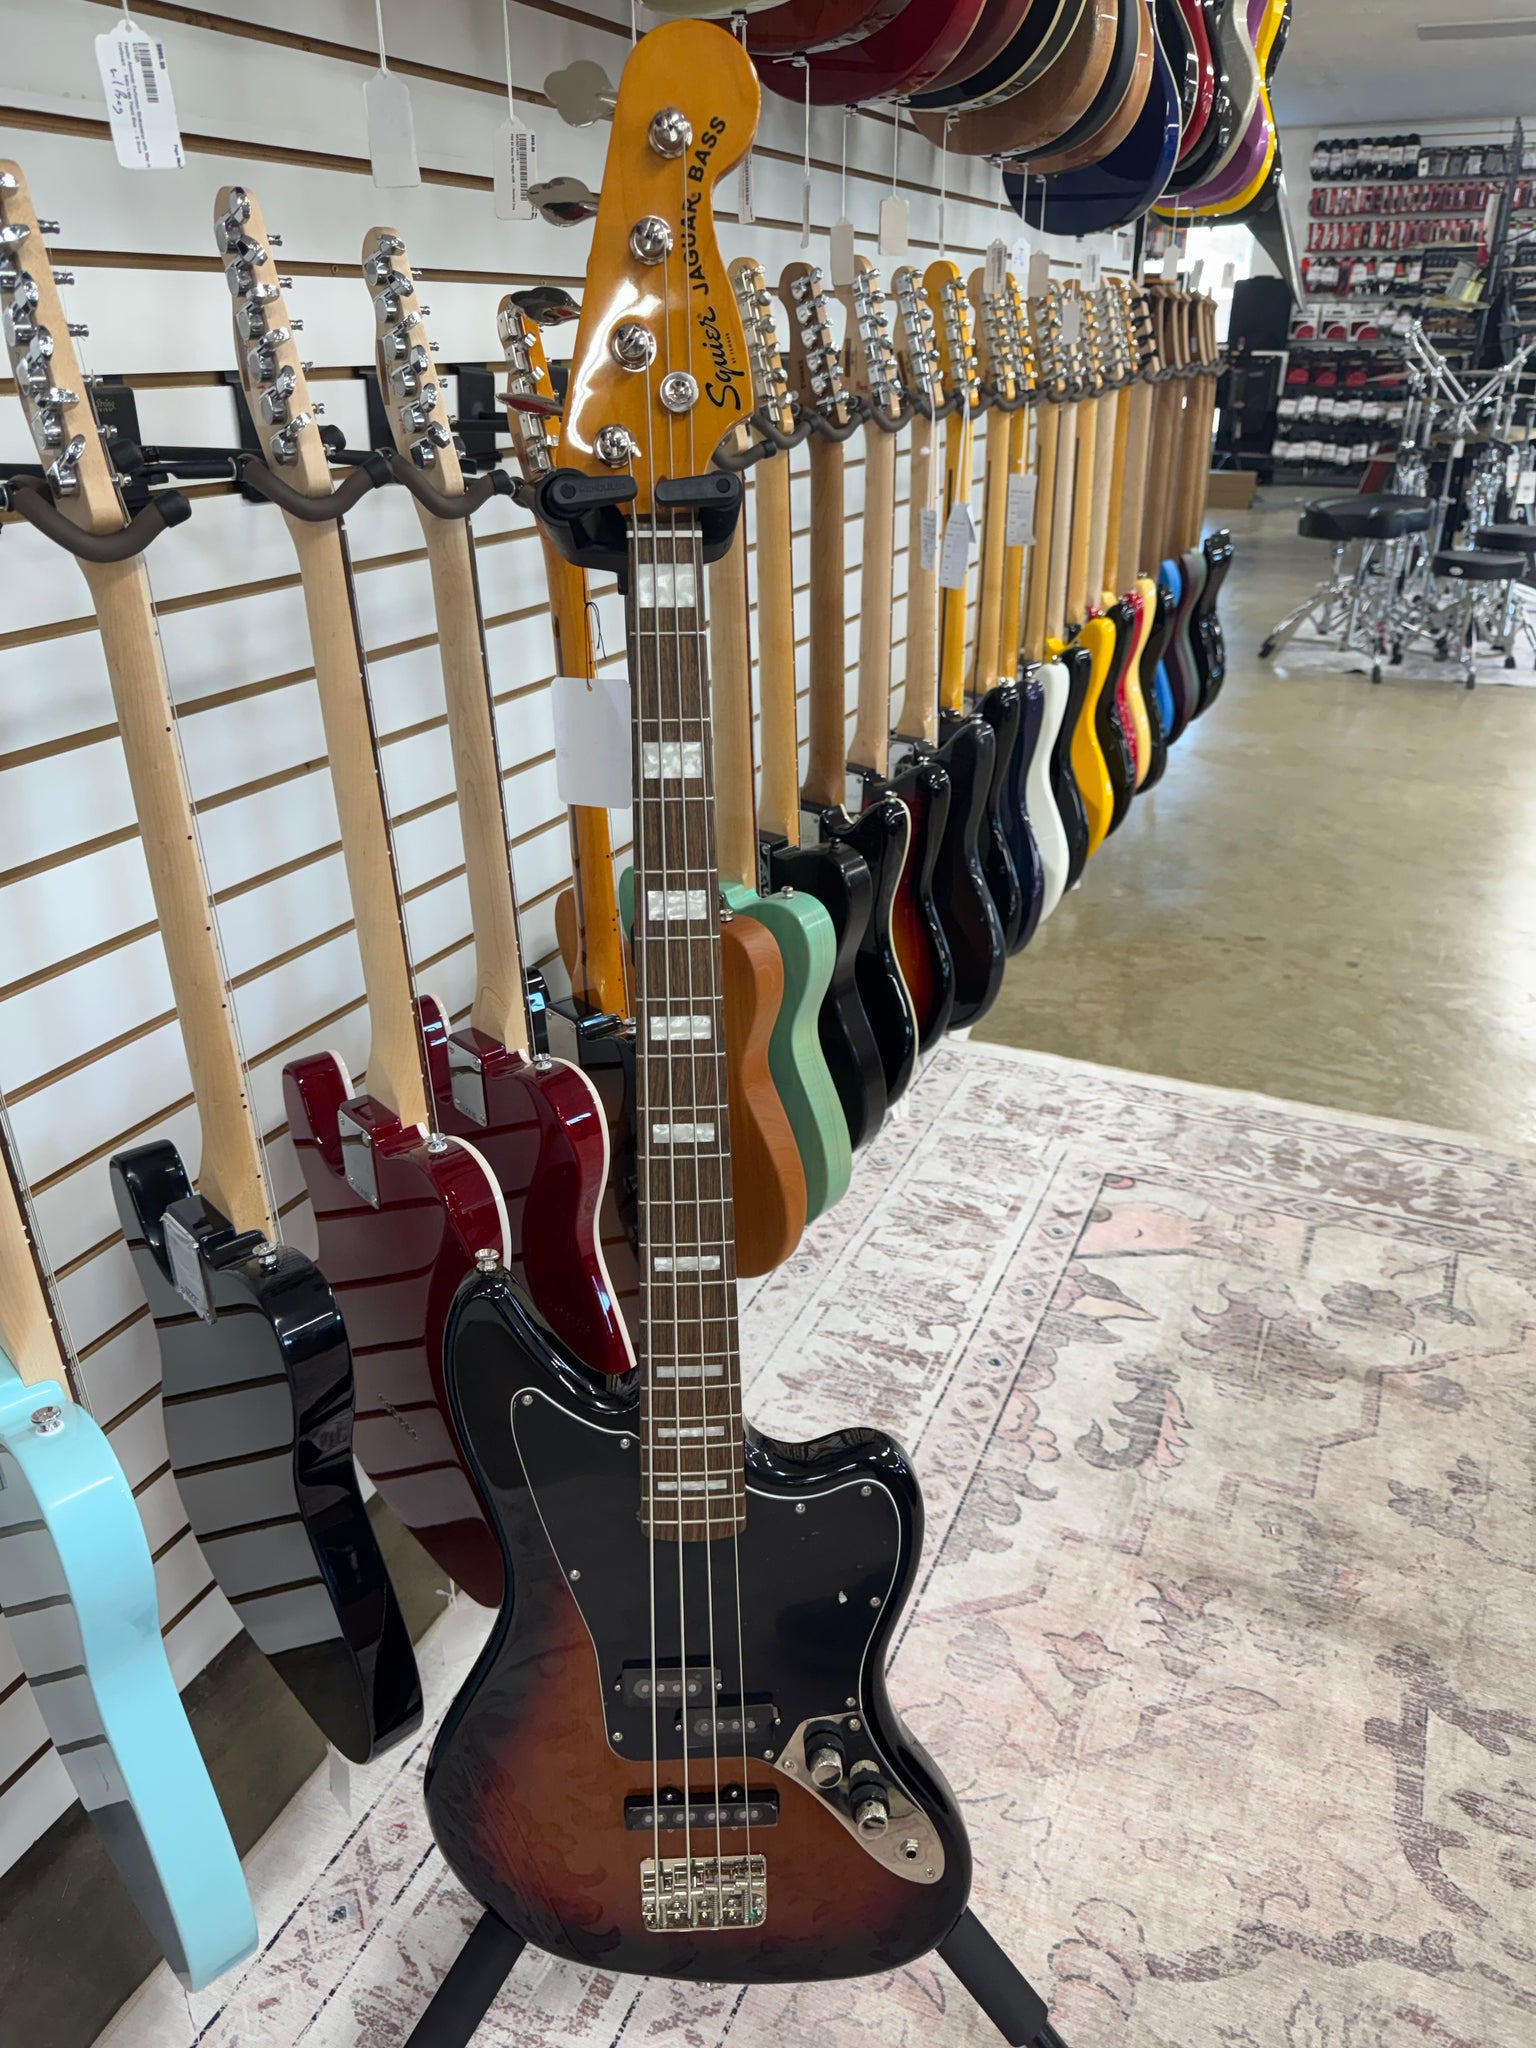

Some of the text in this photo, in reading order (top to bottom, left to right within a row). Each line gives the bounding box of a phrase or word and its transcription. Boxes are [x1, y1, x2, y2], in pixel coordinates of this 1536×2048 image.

[680, 116, 745, 410] Squier JAGUAR BASS
